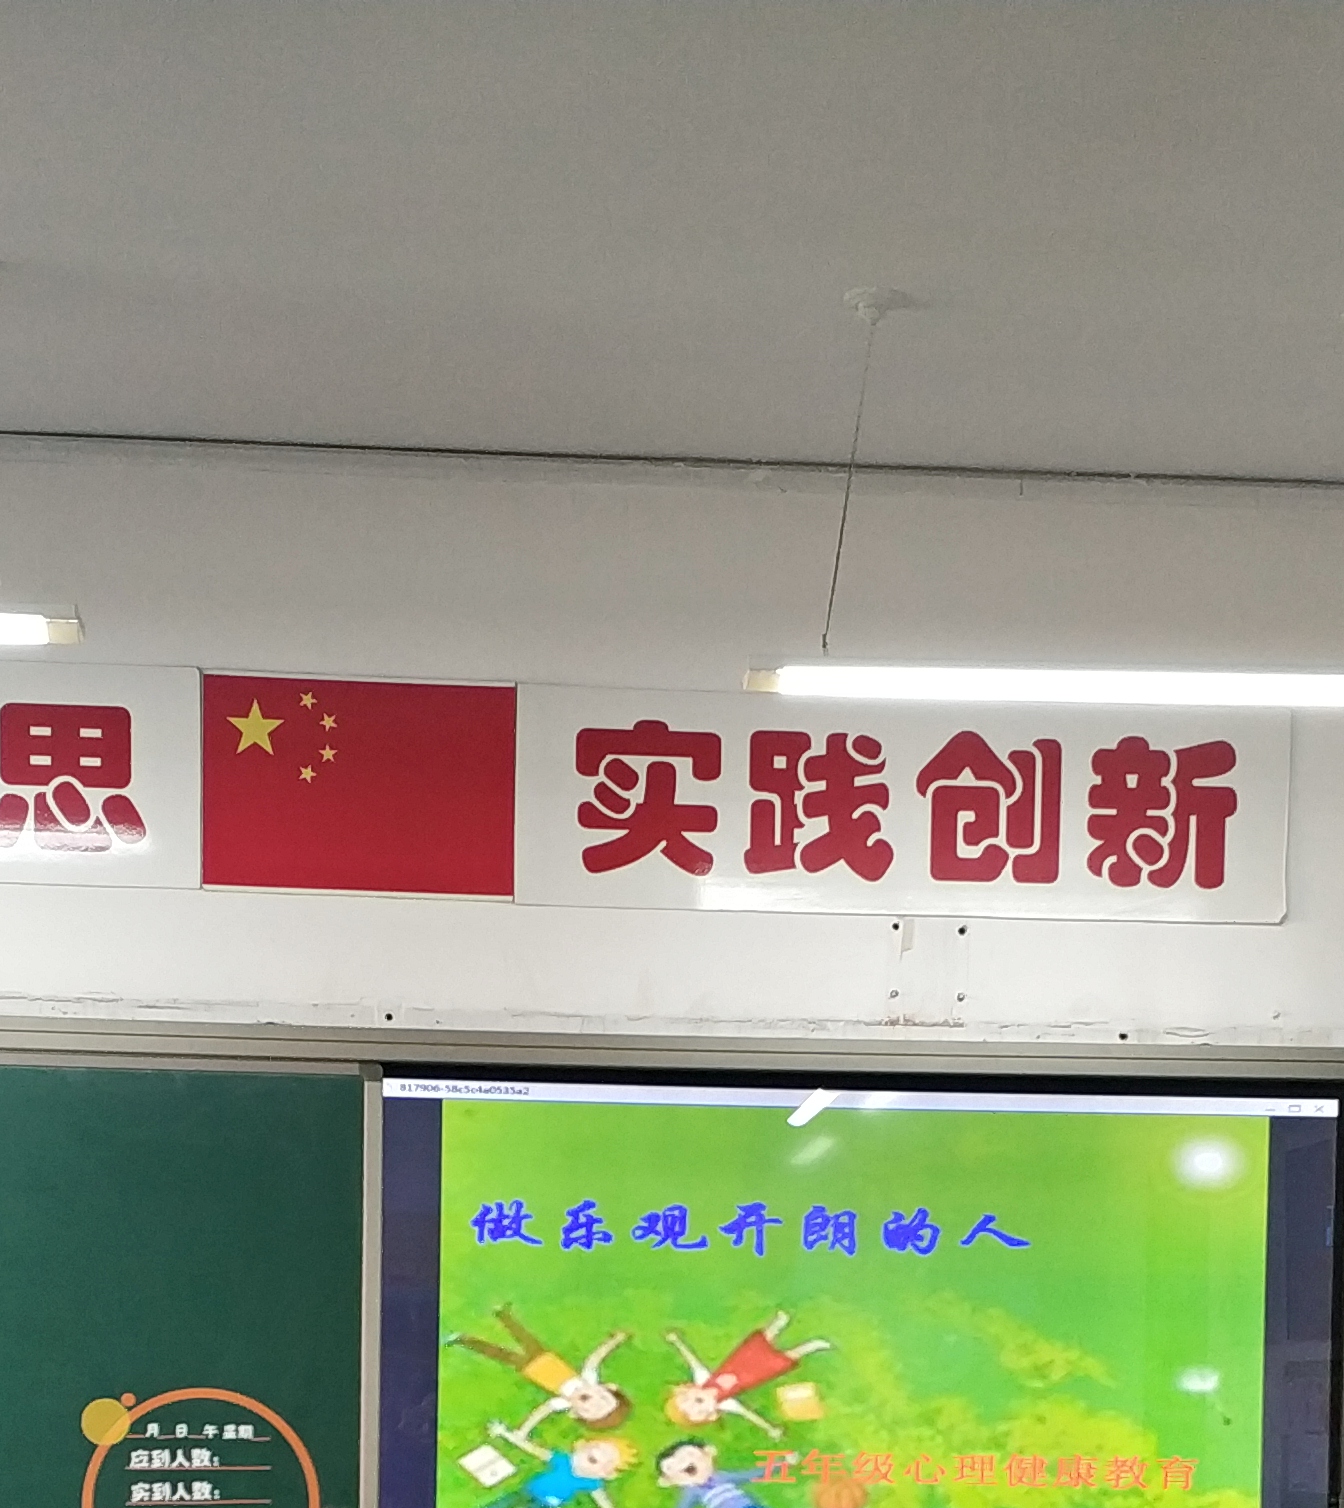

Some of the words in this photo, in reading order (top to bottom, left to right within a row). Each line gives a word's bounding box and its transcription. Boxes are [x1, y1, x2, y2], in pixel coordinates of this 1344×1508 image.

[575, 719, 1239, 890] 实践创新
[470, 1199, 1031, 1257] 做乐观开朗的人
[145, 1423, 160, 1438] 月
[175, 1423, 188, 1438] 日
[222, 1424, 255, 1440] 星期
[749, 1448, 1199, 1491] 五年级心理健康教育
